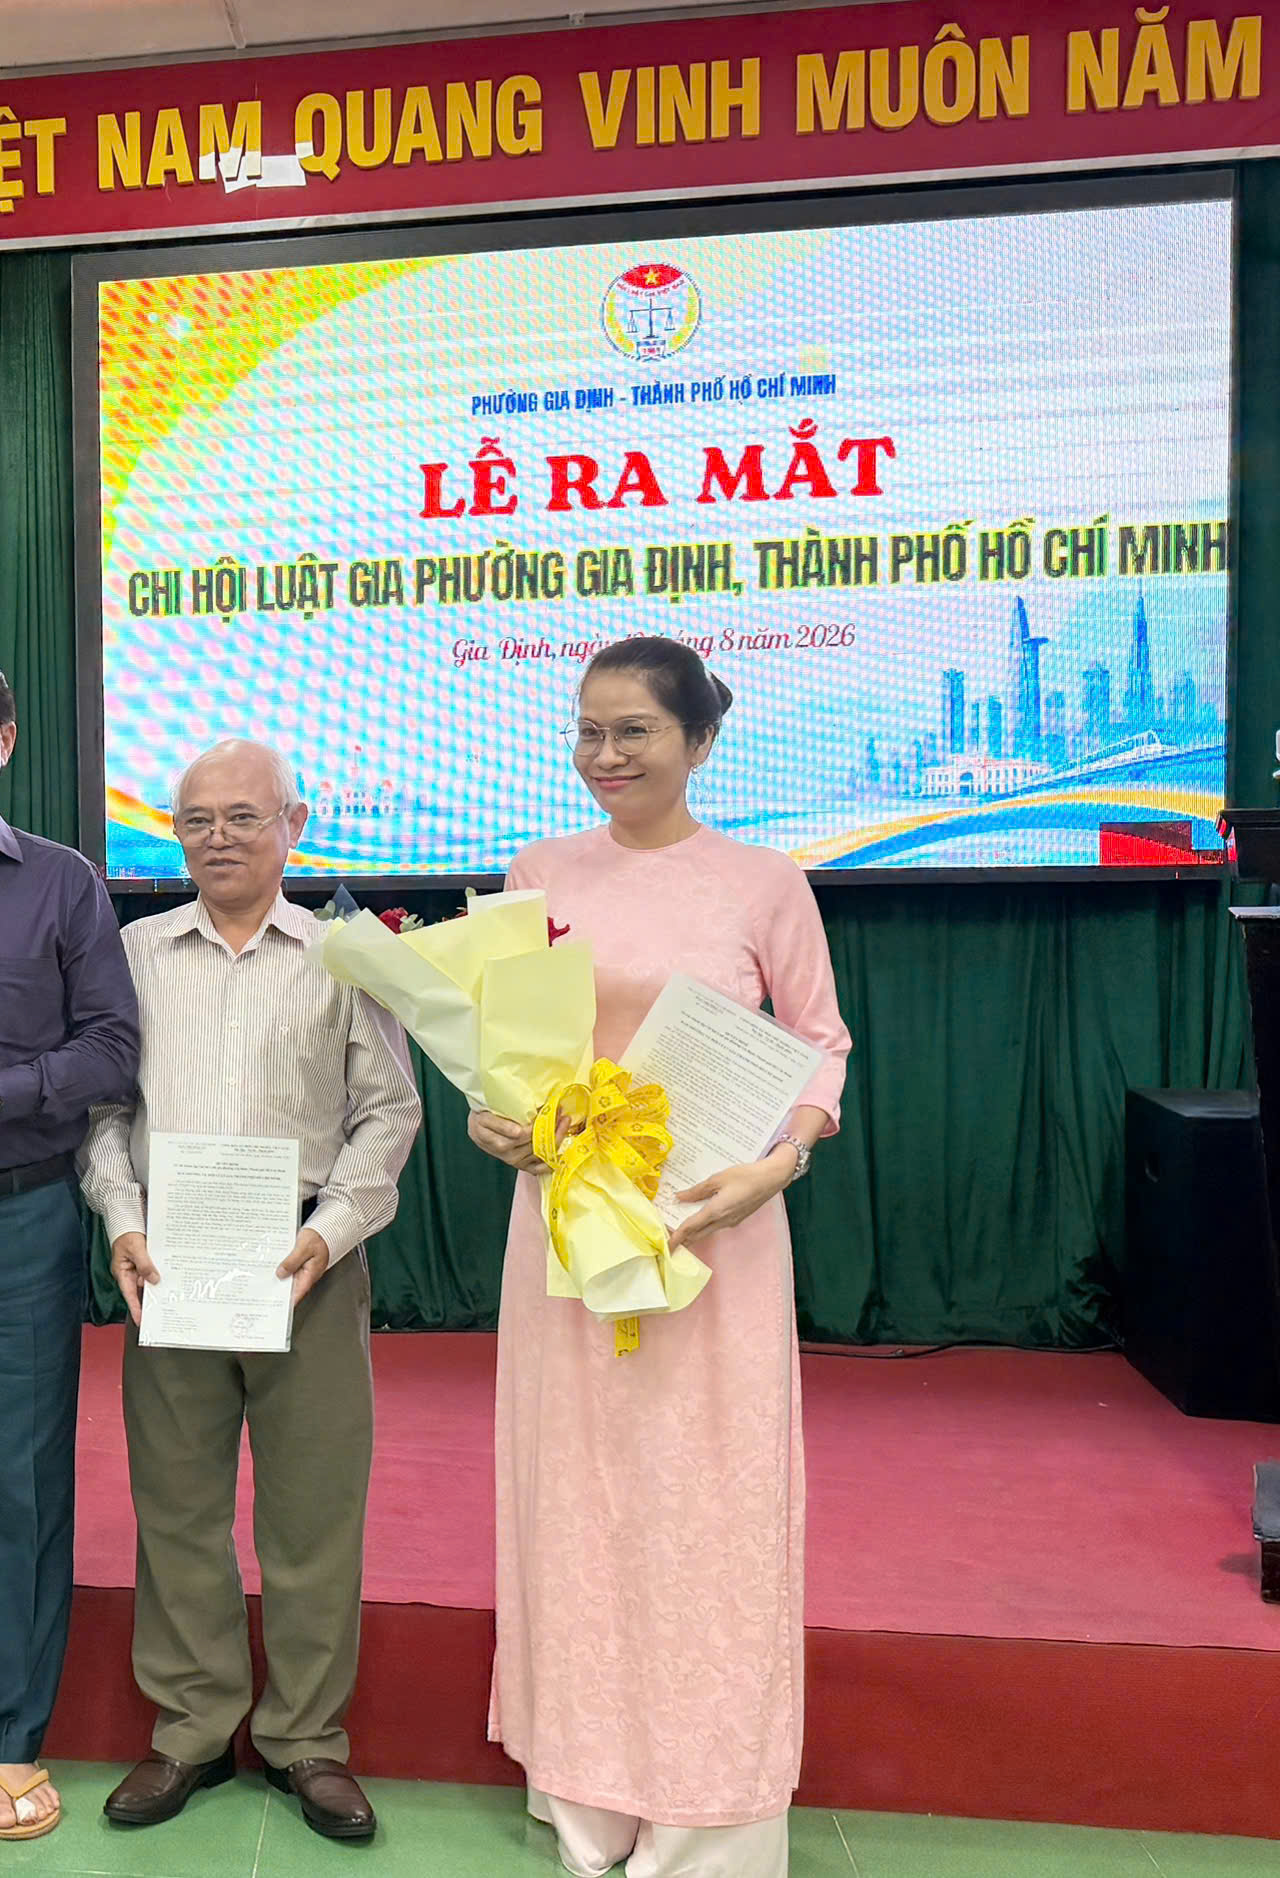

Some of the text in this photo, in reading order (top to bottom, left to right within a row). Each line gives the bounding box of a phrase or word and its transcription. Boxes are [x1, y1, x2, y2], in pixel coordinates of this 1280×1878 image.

[96, 100, 262, 190] NAM
[294, 75, 544, 182] QUANG
[578, 57, 761, 150] VINH
[794, 23, 1031, 133] MUÔN
[1065, 6, 1263, 113] NĂM
[471, 388, 538, 416] PHƯỜNG
[544, 390, 570, 411] GIA
[574, 387, 614, 413] ĐỊNH
[631, 379, 685, 406] THÀNH
[691, 375, 726, 402] PHỐ
[729, 374, 752, 401] HỒ
[757, 371, 786, 398] CHÍ
[790, 374, 837, 396] MINH
[419, 418, 896, 519] LỄ RA MẮT
[129, 514, 1226, 623] CHI HỘI LUẬT GIA PHƯỜNG GIA ĐỊNH, THÀNH PHỐ HỒ CHÍ MINH
[452, 639, 489, 668] Gia
[499, 637, 556, 666] Định,
[720, 628, 734, 650] 8
[738, 628, 793, 651] năm
[795, 623, 856, 648] 2026
